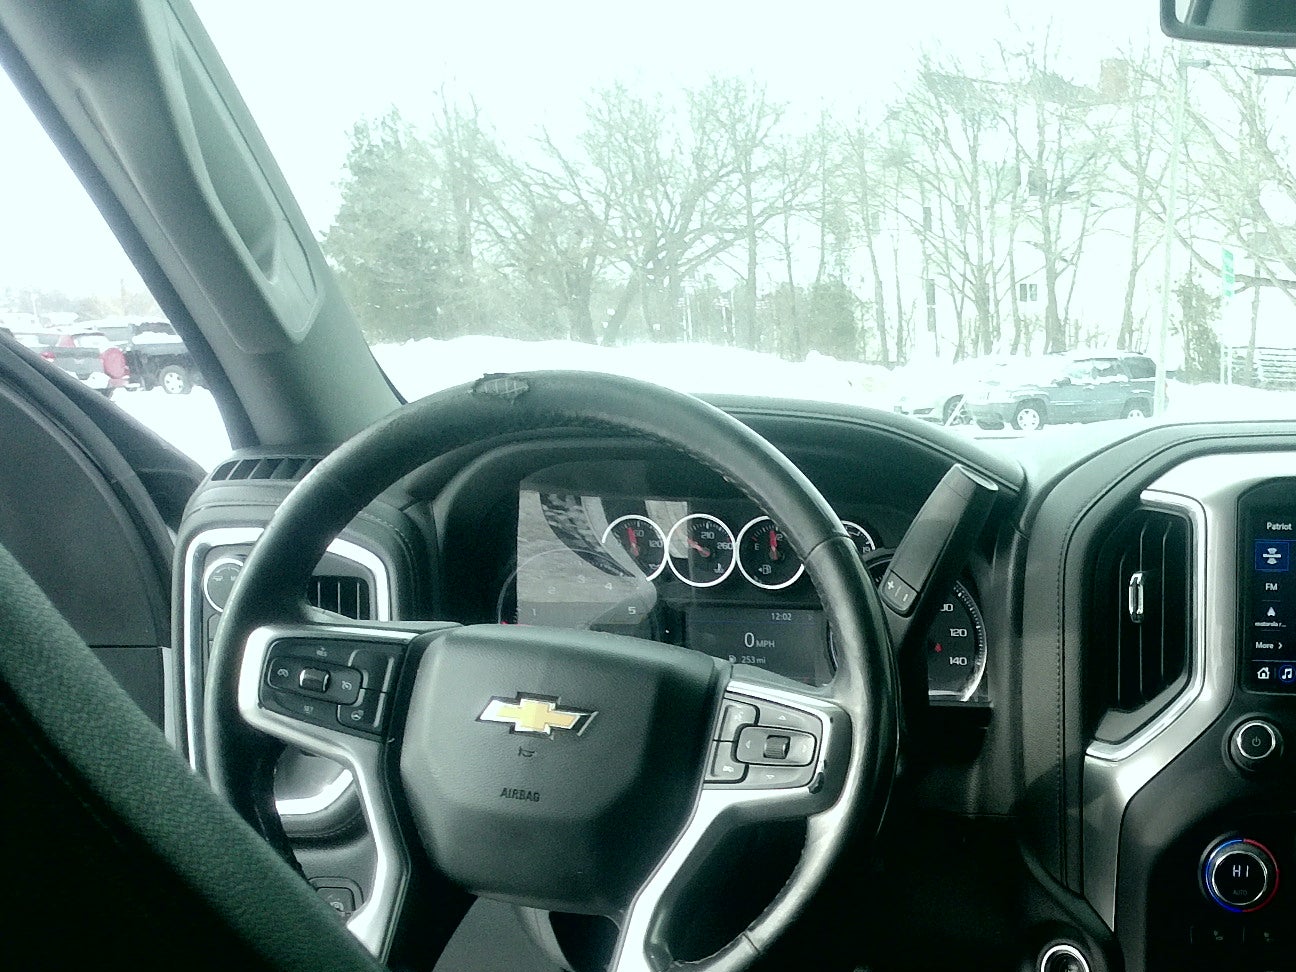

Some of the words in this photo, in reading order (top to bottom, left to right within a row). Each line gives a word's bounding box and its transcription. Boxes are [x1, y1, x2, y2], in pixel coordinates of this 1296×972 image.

[1266, 521, 1293, 531] Patriot
[700, 531, 715, 540] 210
[649, 540, 664, 548] 120
[716, 541, 733, 550] 260
[754, 543, 760, 551] E
[604, 582, 613, 591] 4
[1265, 582, 1278, 591] FM
[627, 605, 637, 615] 5
[771, 612, 792, 621] 12:02
[949, 628, 968, 637] 120
[744, 632, 755, 648] 0
[755, 640, 776, 648] MPH
[1255, 641, 1275, 650] More
[741, 655, 756, 664] 253
[756, 656, 766, 664] mi
[949, 656, 968, 666] 140
[500, 787, 541, 802] AIRBAG
[1232, 864, 1250, 878] HI
[1232, 888, 1248, 896] AUTO
